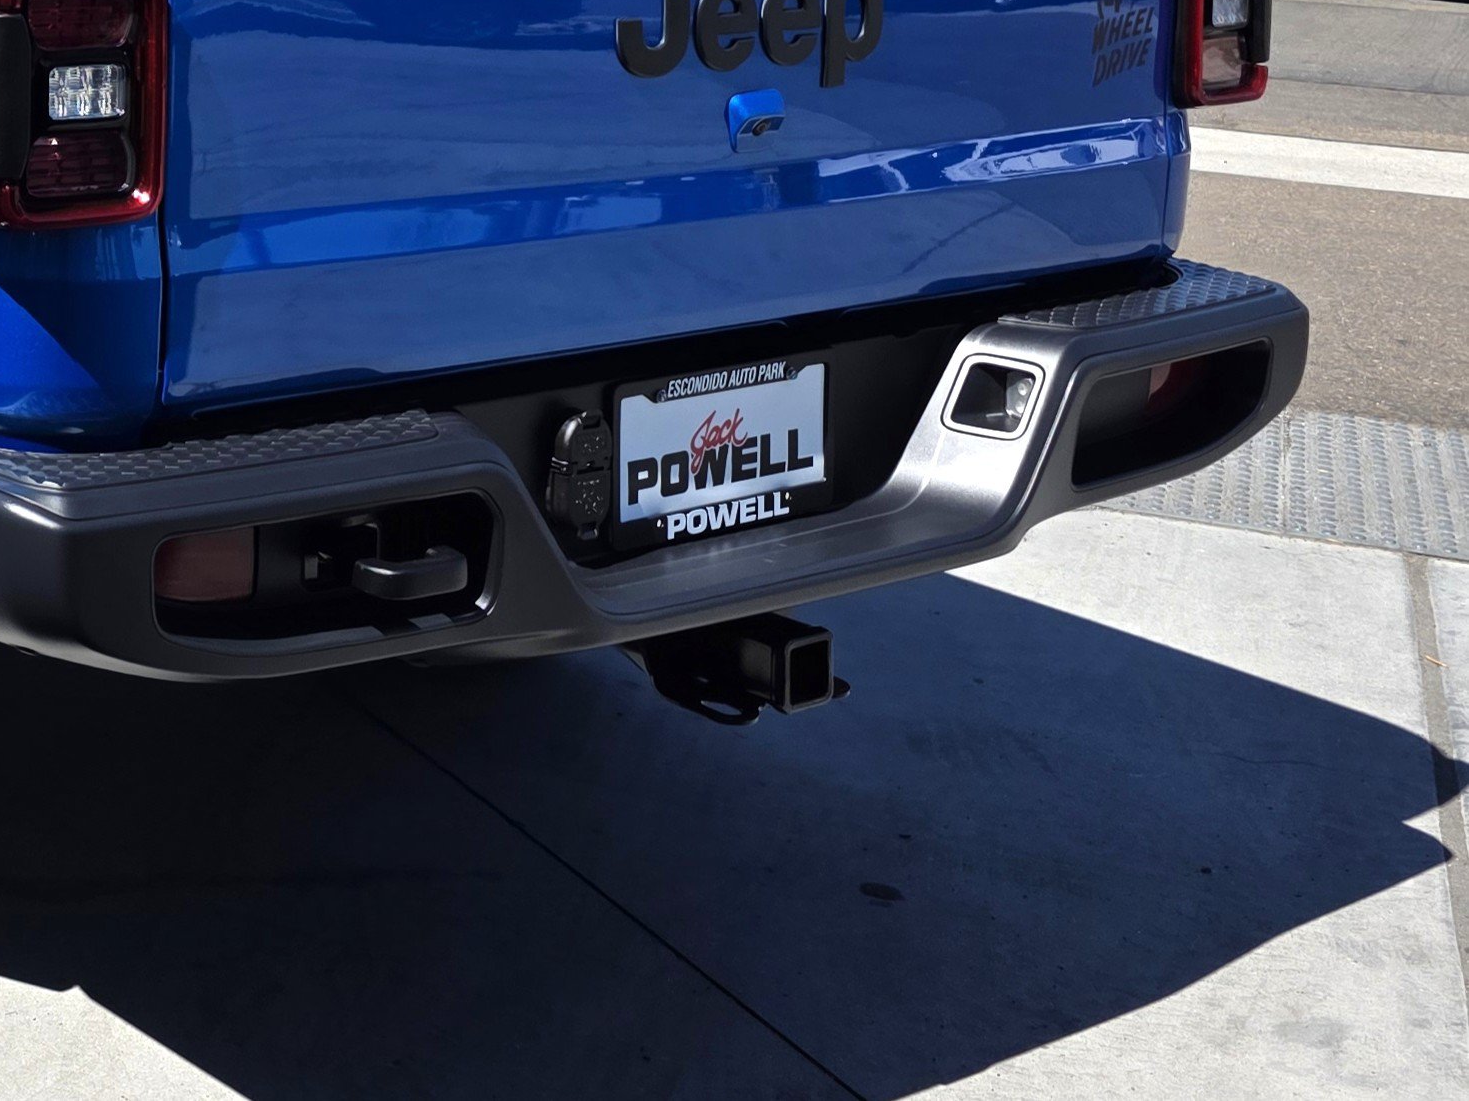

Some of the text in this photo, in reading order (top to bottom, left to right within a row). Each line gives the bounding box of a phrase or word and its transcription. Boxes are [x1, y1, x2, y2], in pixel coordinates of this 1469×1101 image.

[1092, 6, 1154, 54] WHEEL
[1092, 38, 1151, 88] DRIVE
[667, 361, 787, 398] ESCONDIDO AUTO PARK
[690, 408, 748, 475] Jack
[627, 428, 814, 506] POWELL
[666, 491, 790, 540] POWELL
